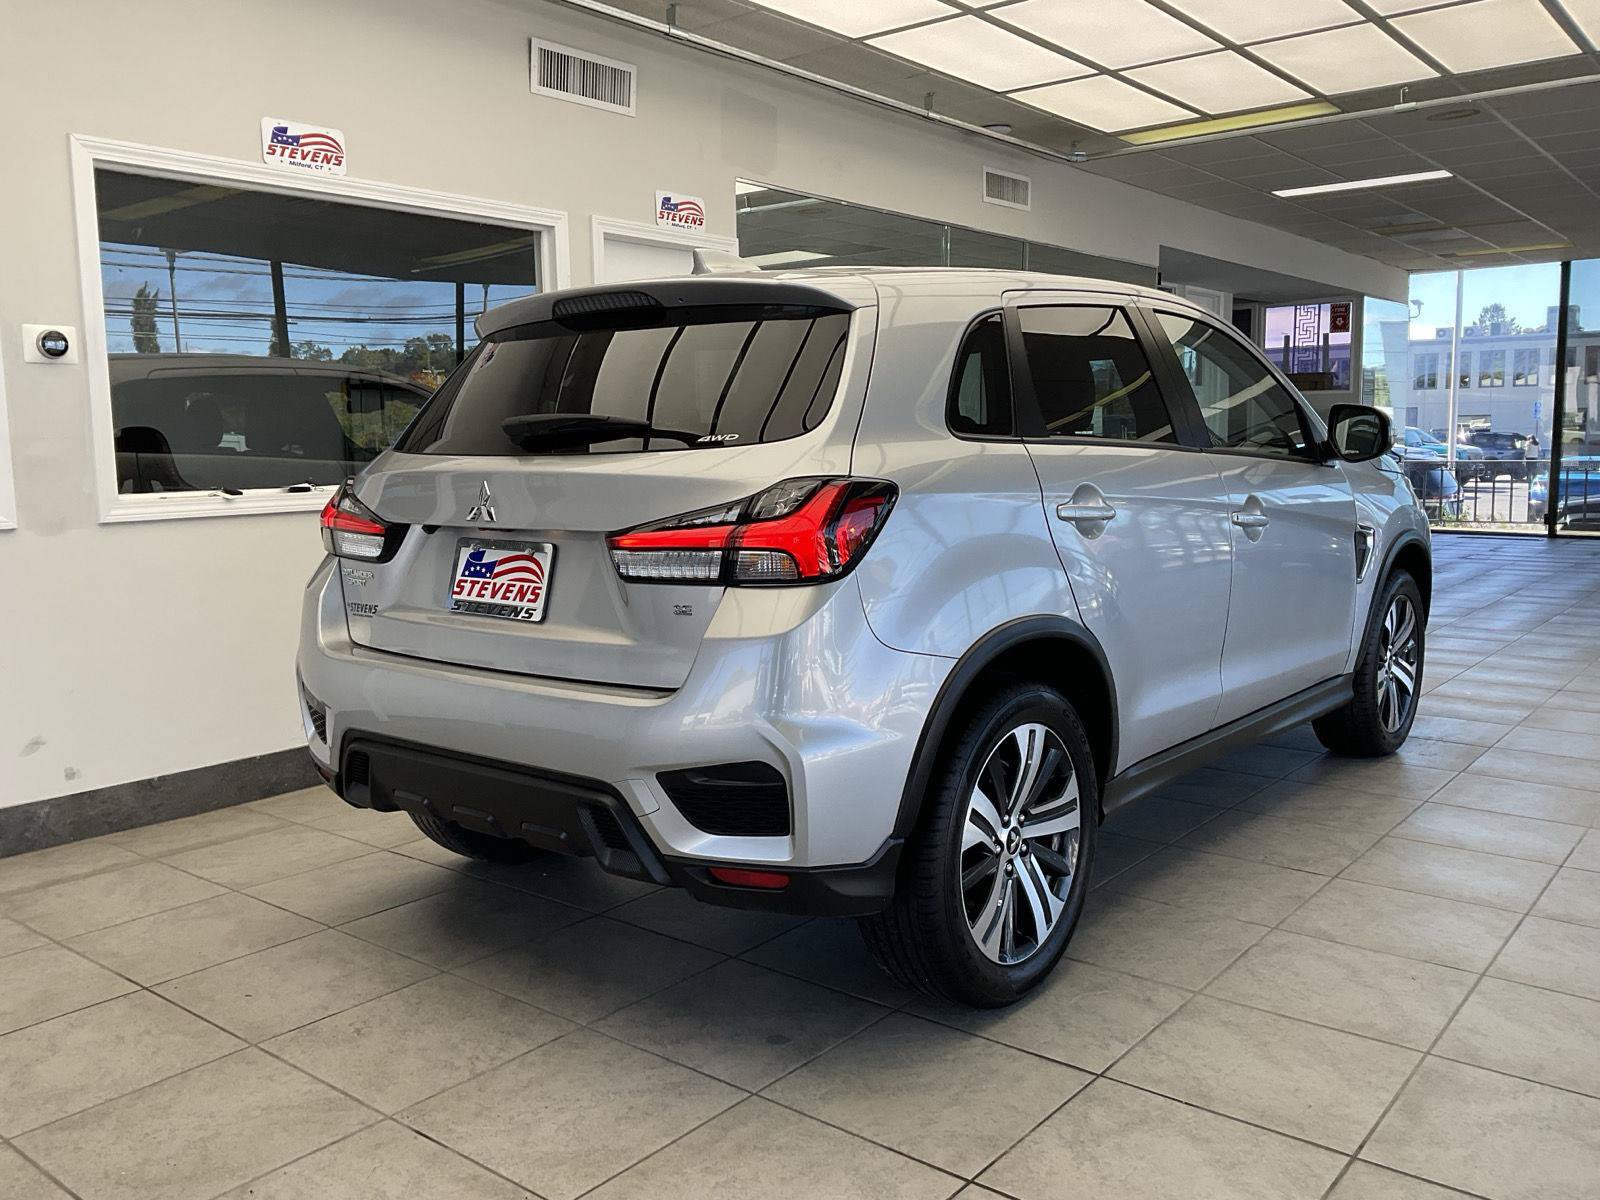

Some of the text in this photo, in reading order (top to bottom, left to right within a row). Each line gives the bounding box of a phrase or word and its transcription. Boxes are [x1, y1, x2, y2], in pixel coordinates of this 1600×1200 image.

[266, 143, 344, 167] STEVENS
[289, 160, 313, 170] Milford,
[658, 210, 705, 226] STEVENS
[451, 578, 543, 604] STEVENS
[350, 602, 379, 615] STEVENS
[451, 600, 537, 620] STEVENS
